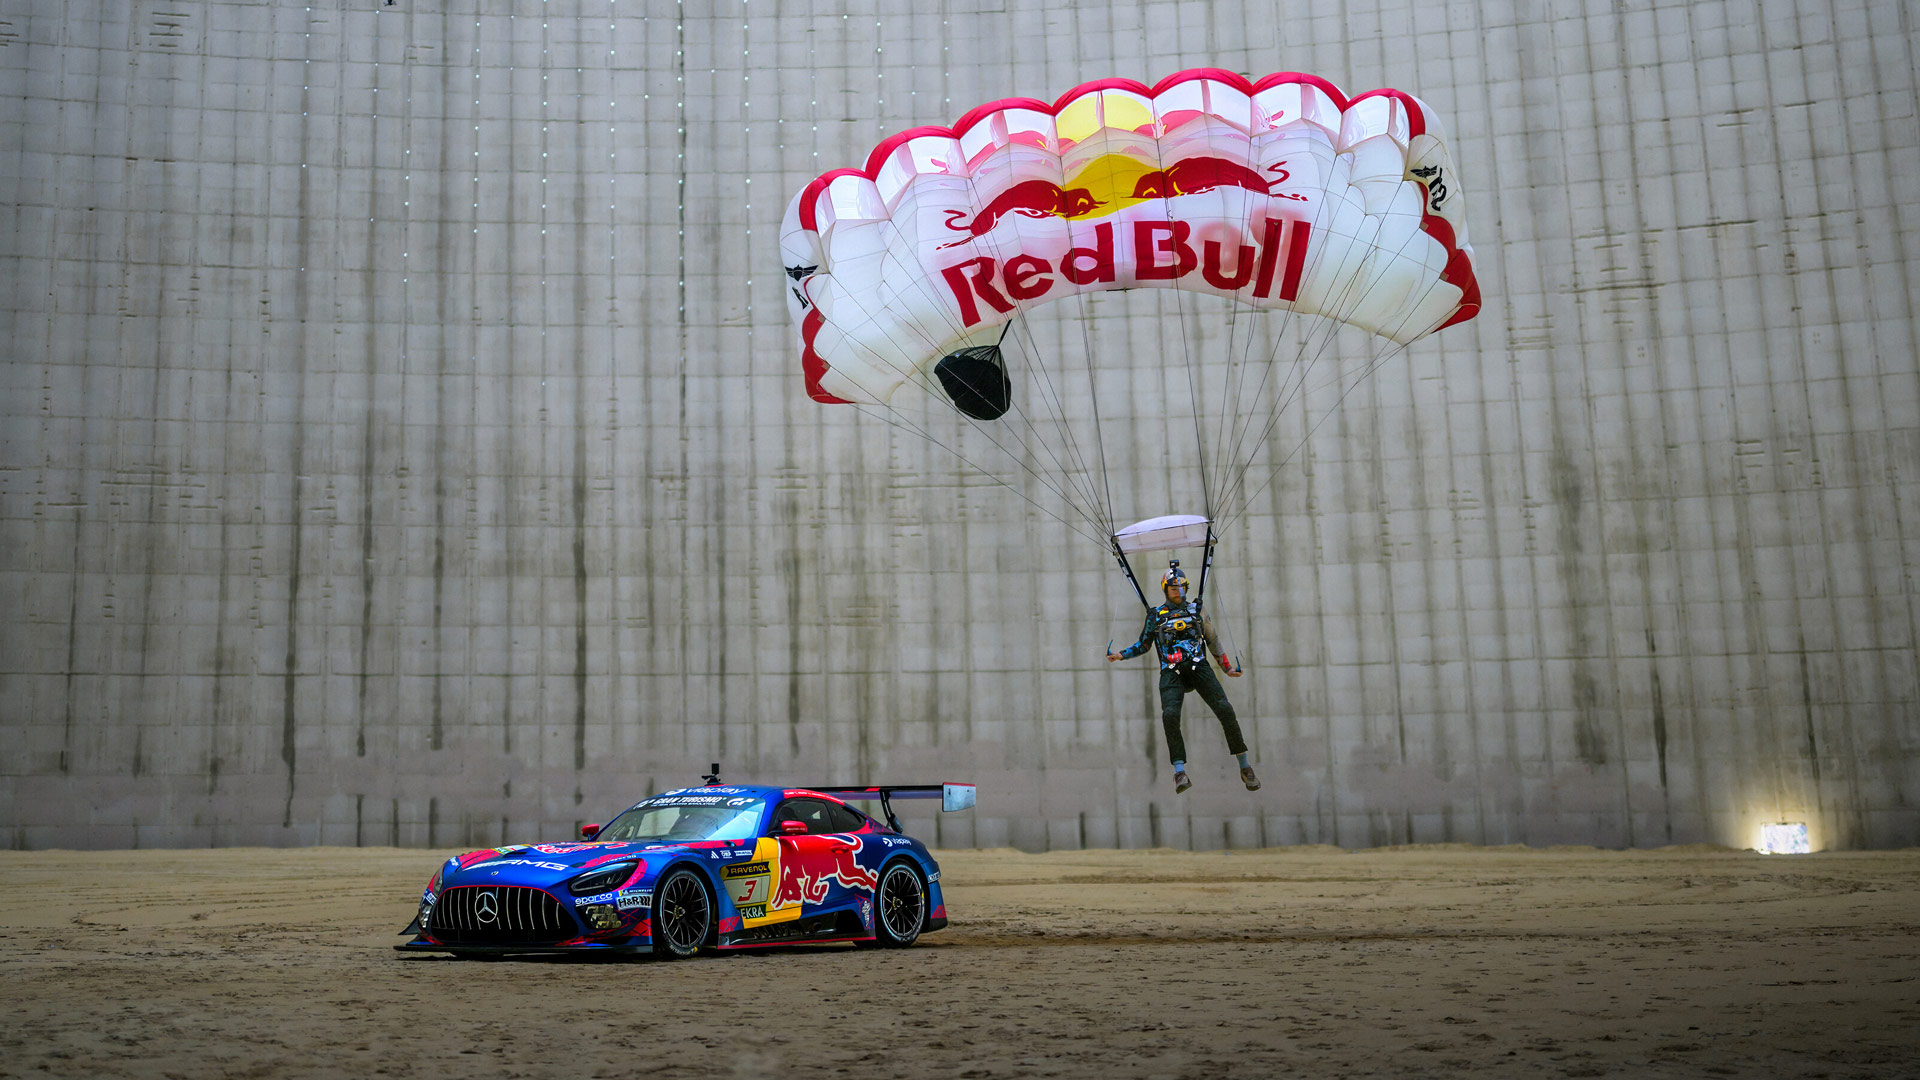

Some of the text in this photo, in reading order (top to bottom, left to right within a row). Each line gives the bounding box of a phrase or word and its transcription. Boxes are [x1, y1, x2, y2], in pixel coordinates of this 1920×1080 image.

[941, 217, 1311, 328] Red Bull
[504, 859, 569, 871] AMG
[730, 864, 768, 875] RAVENOL
[736, 880, 758, 902] 3
[574, 892, 613, 907] sparco
[617, 896, 640, 908] H&R
[738, 905, 765, 919] EKRA
